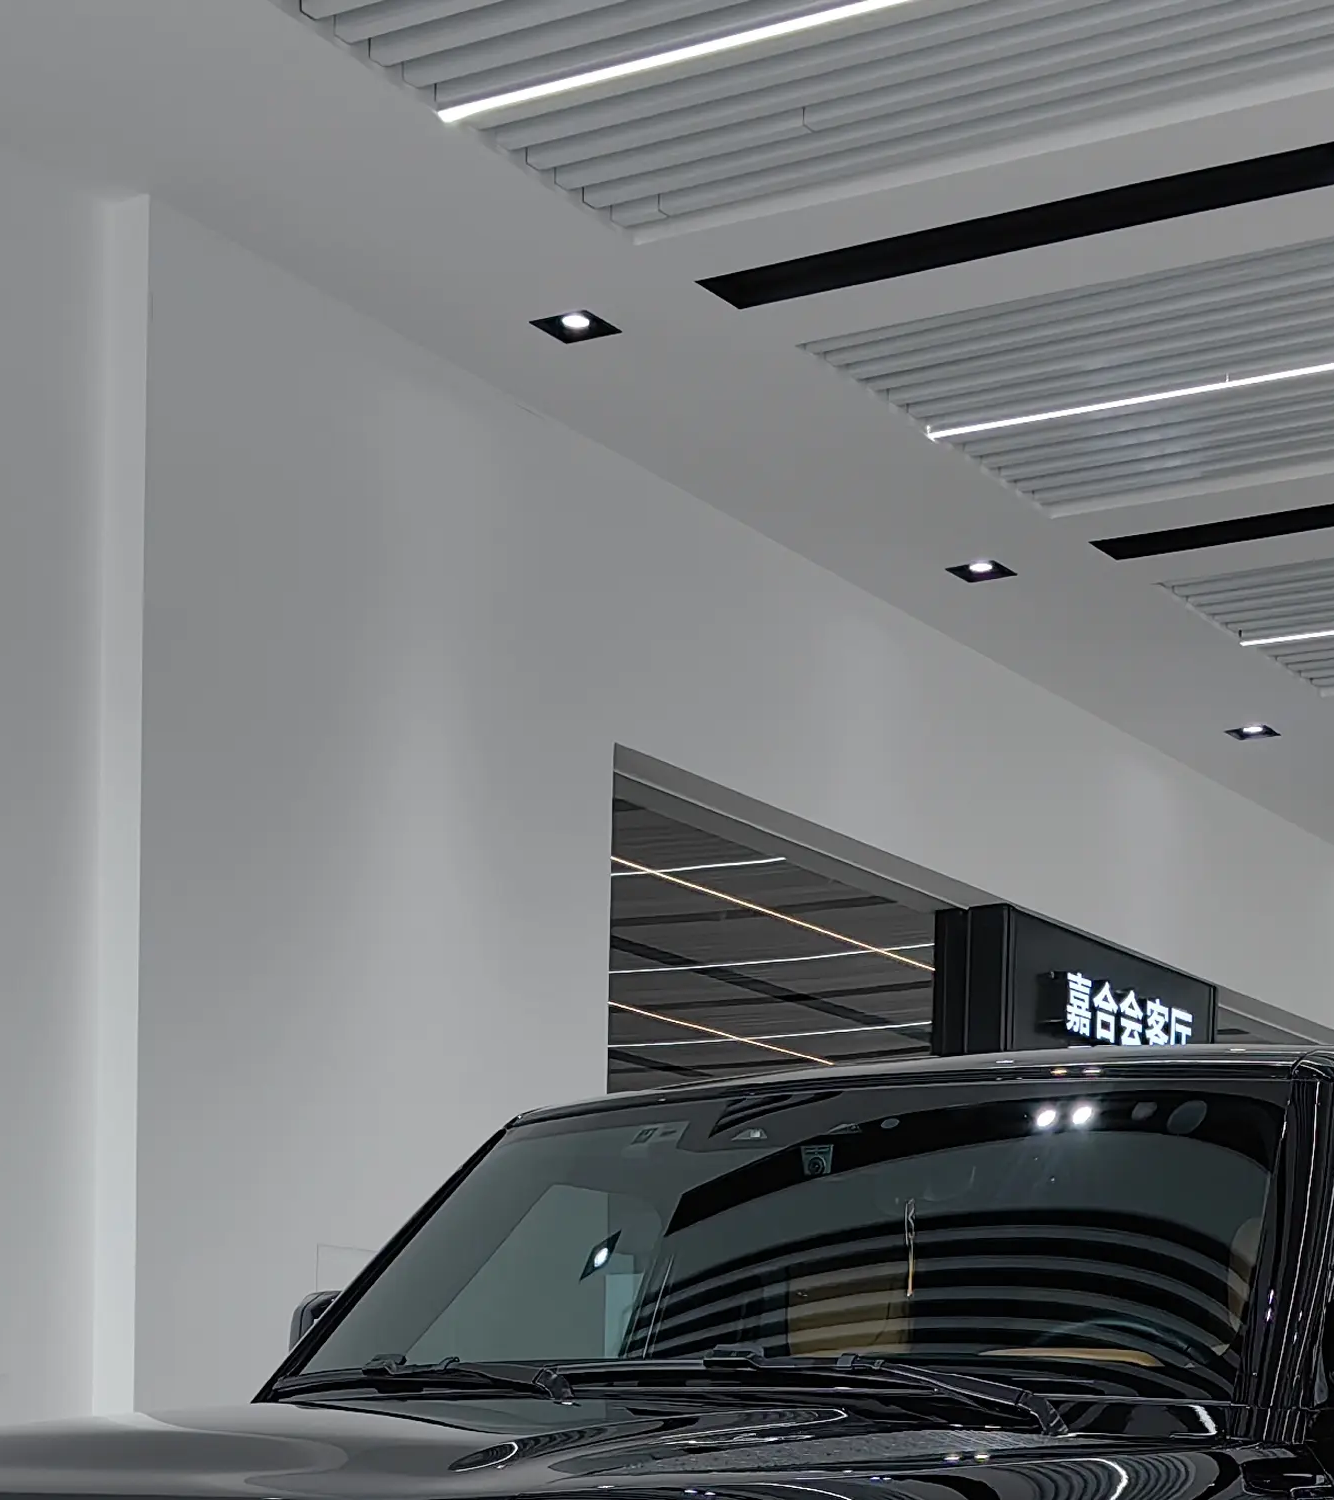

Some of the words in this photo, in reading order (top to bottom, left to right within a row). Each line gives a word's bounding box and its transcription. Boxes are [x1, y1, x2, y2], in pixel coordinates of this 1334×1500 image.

[1066, 971, 1193, 1046] 嘉合会客厅
